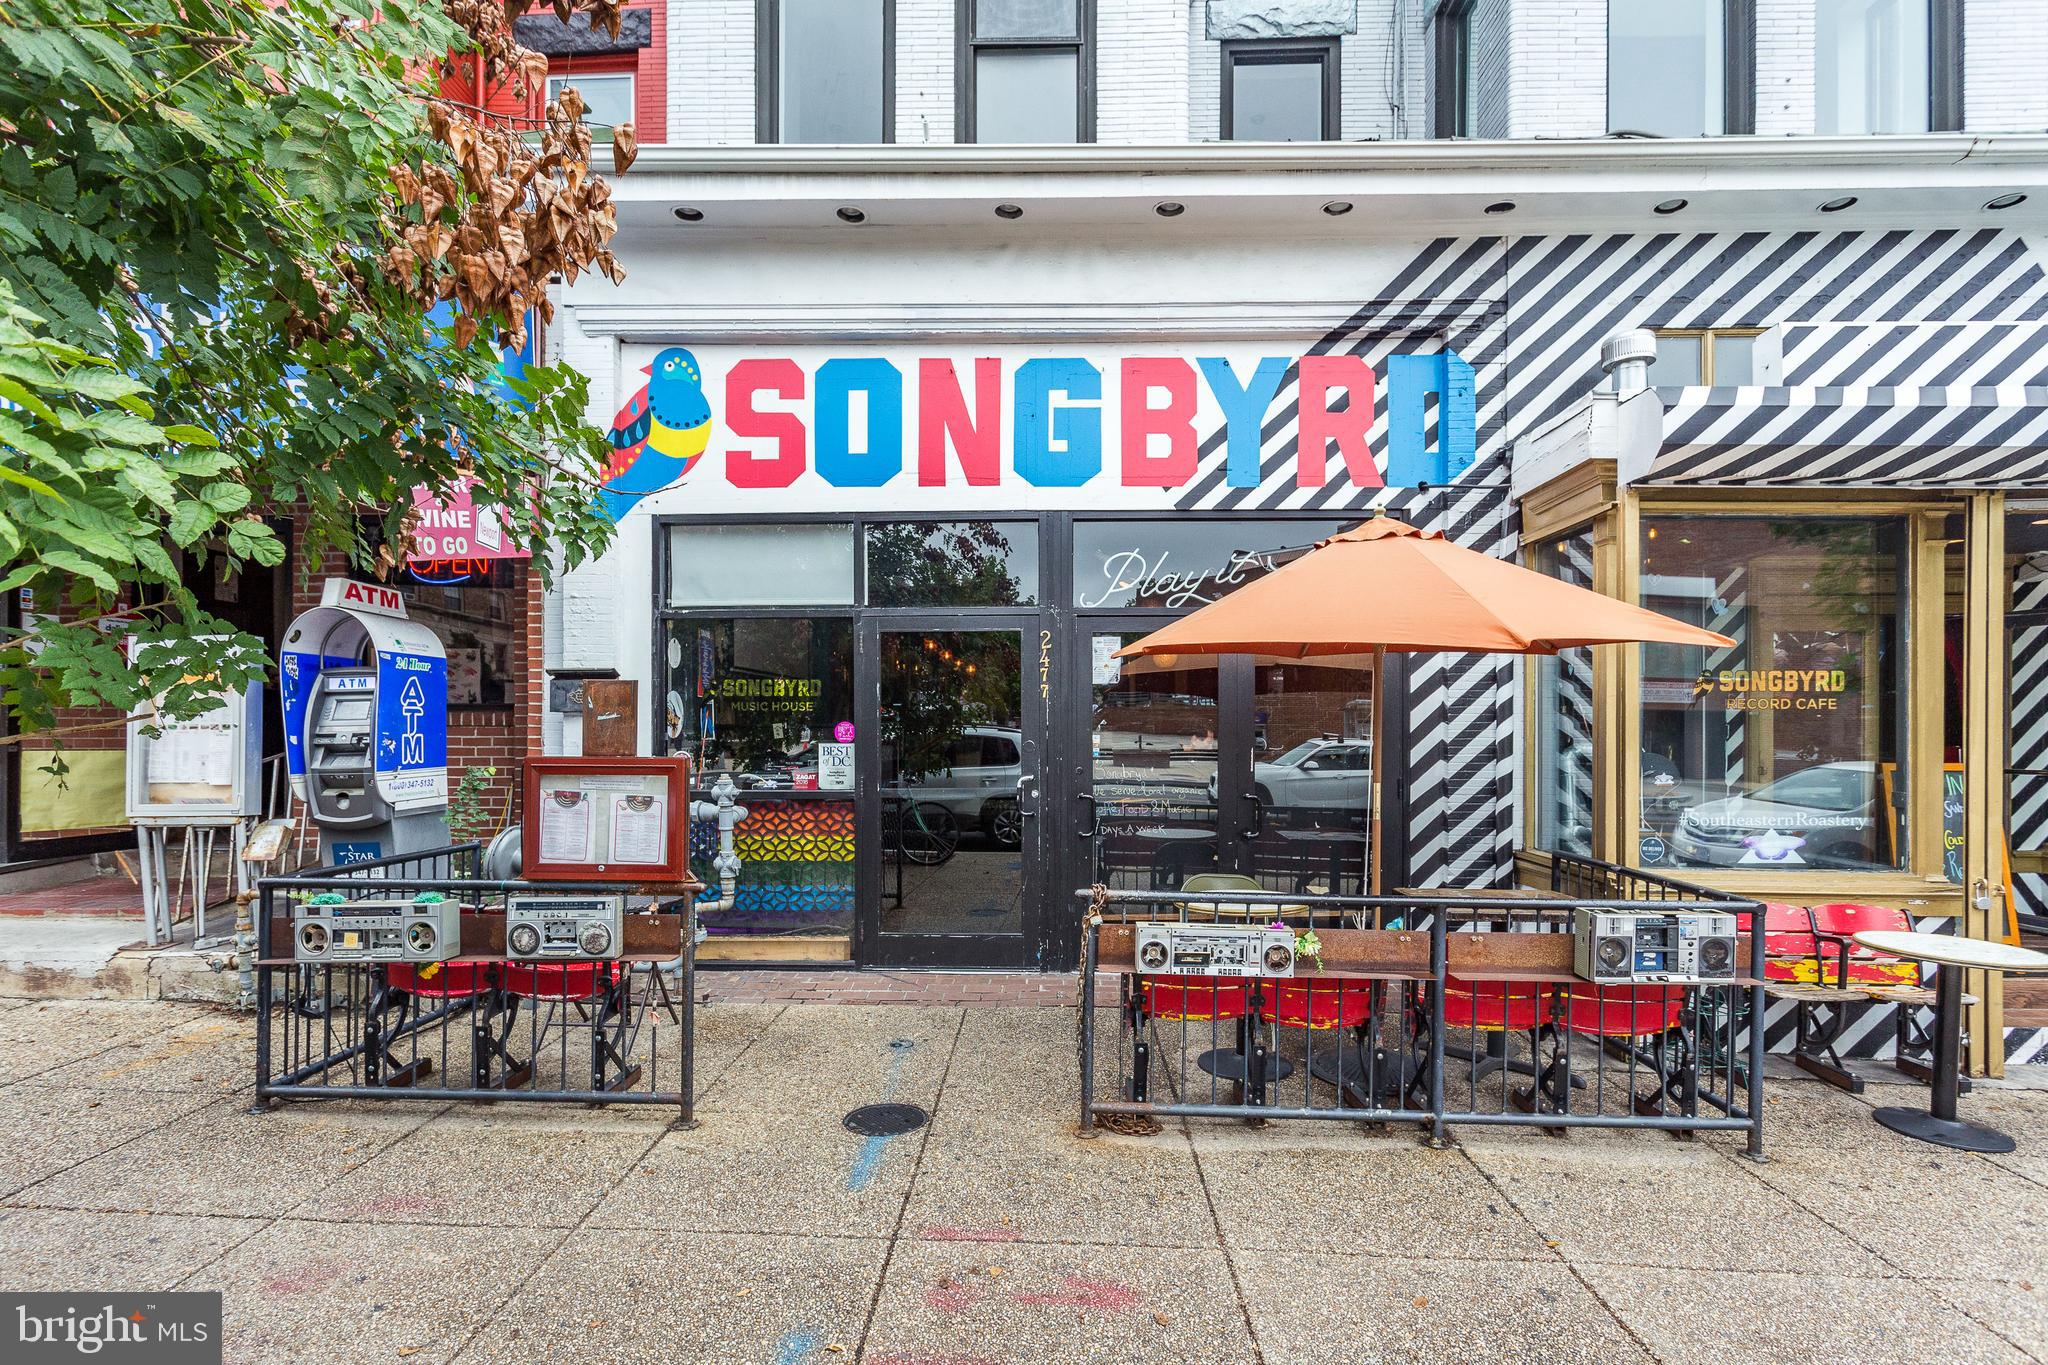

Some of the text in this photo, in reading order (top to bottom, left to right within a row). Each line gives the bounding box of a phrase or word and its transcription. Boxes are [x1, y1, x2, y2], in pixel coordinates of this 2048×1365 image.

[725, 354, 1476, 488] SONGBYRD
[442, 536, 468, 555] GO
[1080, 548, 1260, 608] Play it
[344, 582, 400, 610] ATM
[1039, 630, 1052, 698] 2477
[337, 678, 368, 689] ATM
[722, 679, 822, 697] SONGBYRD
[1719, 670, 1845, 692] SONGBYRD
[731, 701, 814, 712] MUSIC HOUSE
[1726, 698, 1838, 710] RECORD CAFE
[400, 675, 425, 765] ATM
[822, 746, 851, 756] BEST
[1111, 788, 1136, 797] serve
[1124, 824, 1135, 835] A
[347, 852, 376, 861] STAR
